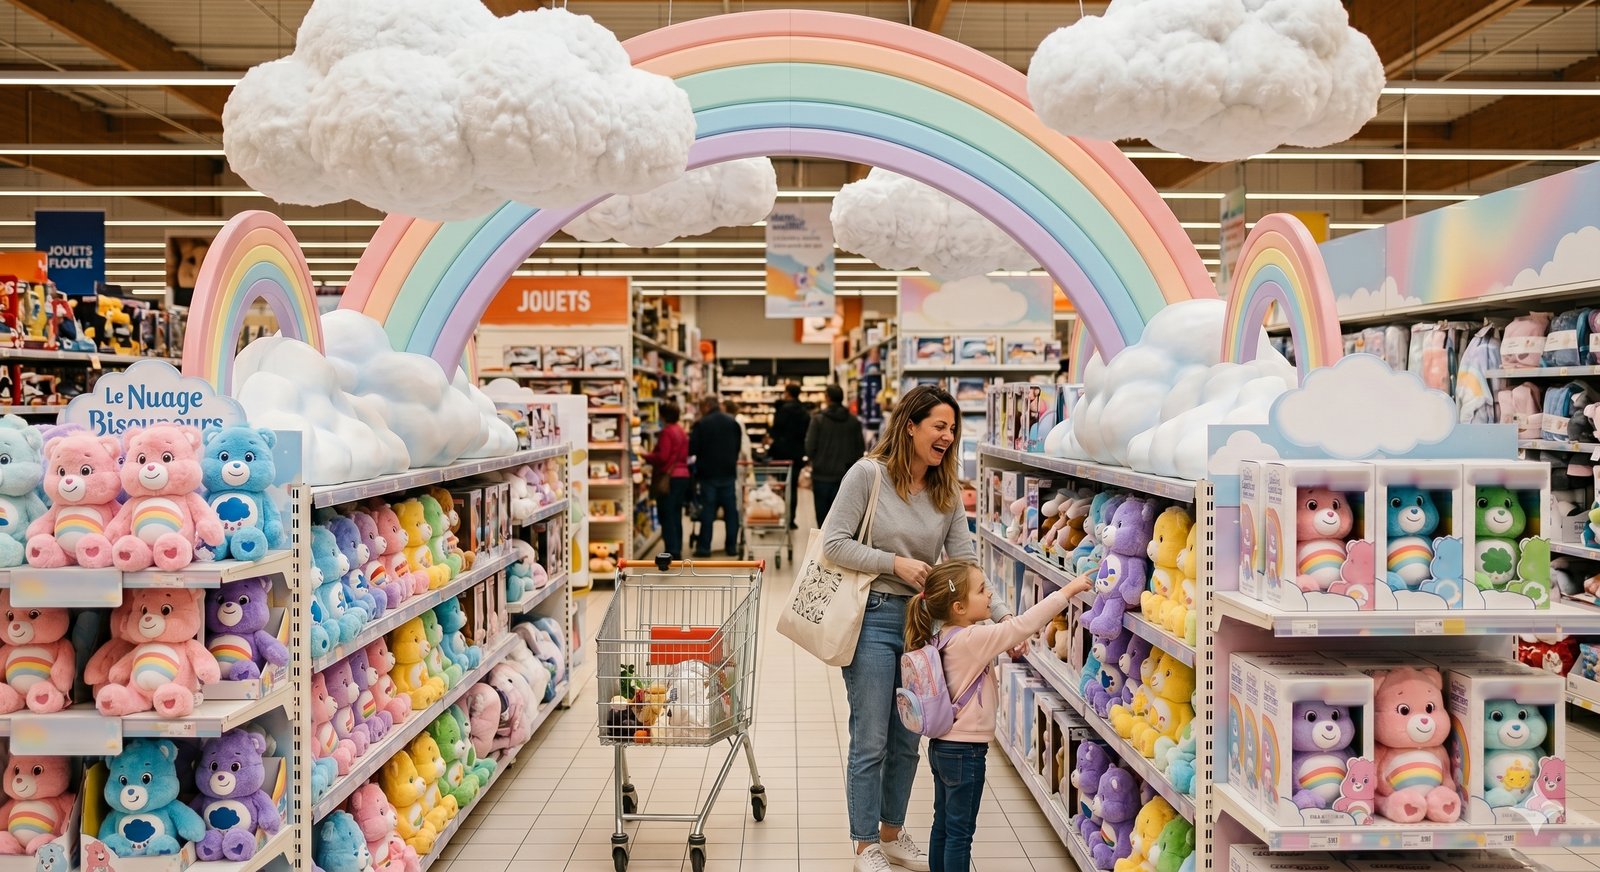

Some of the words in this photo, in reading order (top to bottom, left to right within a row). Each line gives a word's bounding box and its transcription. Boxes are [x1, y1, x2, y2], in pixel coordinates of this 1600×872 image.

[48, 246, 93, 256] JOUETS
[516, 290, 591, 312] JOUETS
[106, 387, 124, 404] Le
[128, 384, 203, 415] Nuage
[89, 410, 224, 437] Bisouurs
